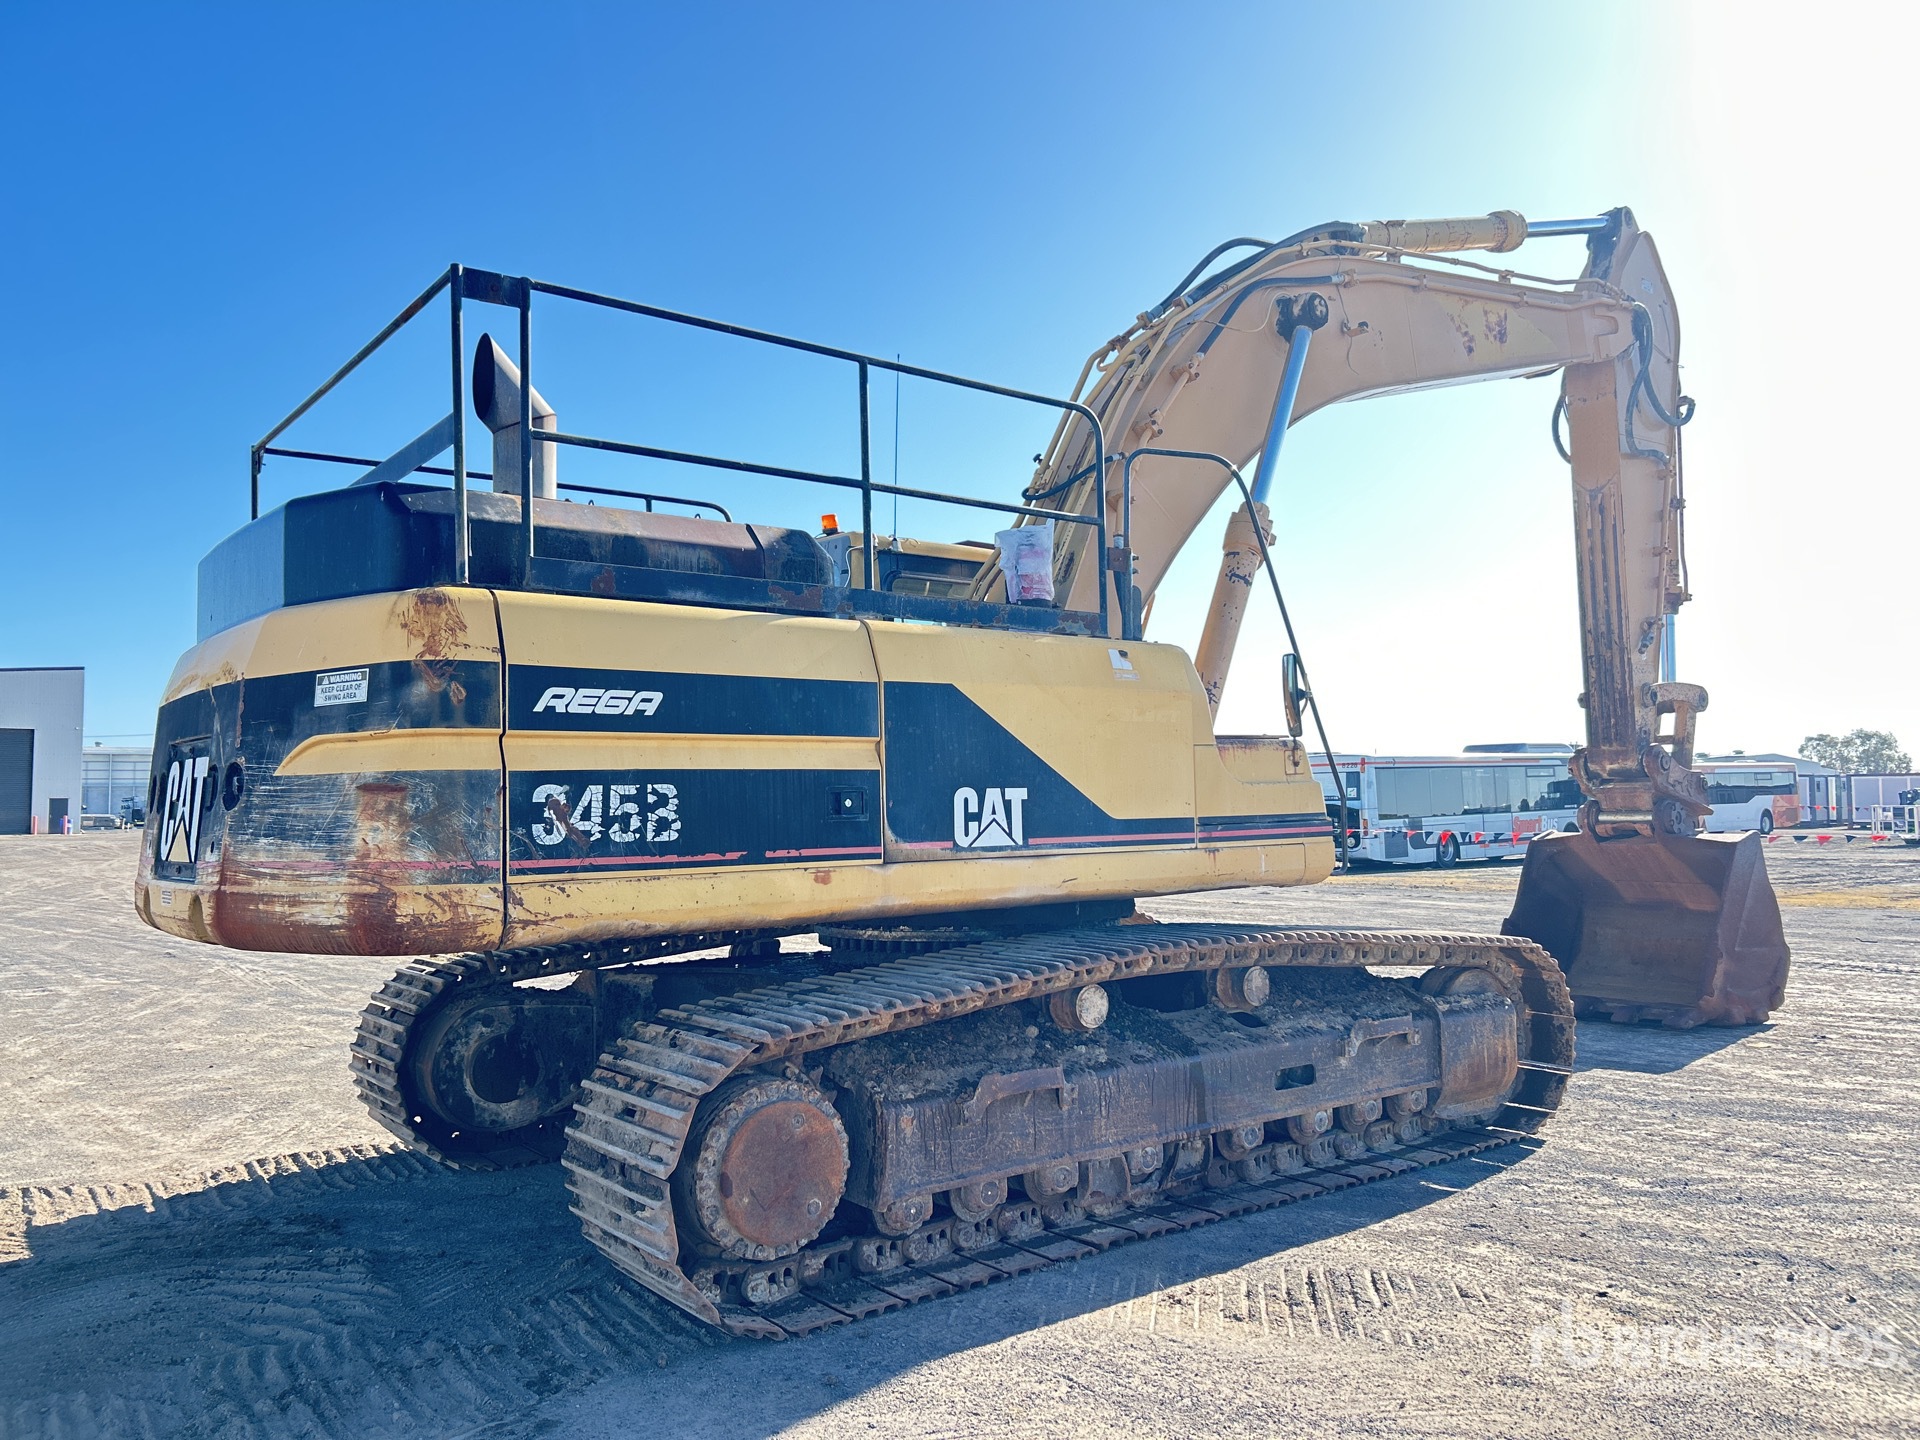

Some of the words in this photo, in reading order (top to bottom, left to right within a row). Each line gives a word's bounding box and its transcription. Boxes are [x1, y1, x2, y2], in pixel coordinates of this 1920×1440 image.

[321, 686, 335, 694] KEEP
[336, 684, 353, 692] CLEAR
[354, 682, 362, 691] OF
[330, 672, 362, 683] WARNING
[325, 694, 341, 702] SWING
[342, 692, 357, 700] AREA
[533, 687, 664, 716] REGA
[160, 756, 210, 863] CAT
[531, 783, 682, 845] 345B
[953, 786, 1028, 848] CAT
